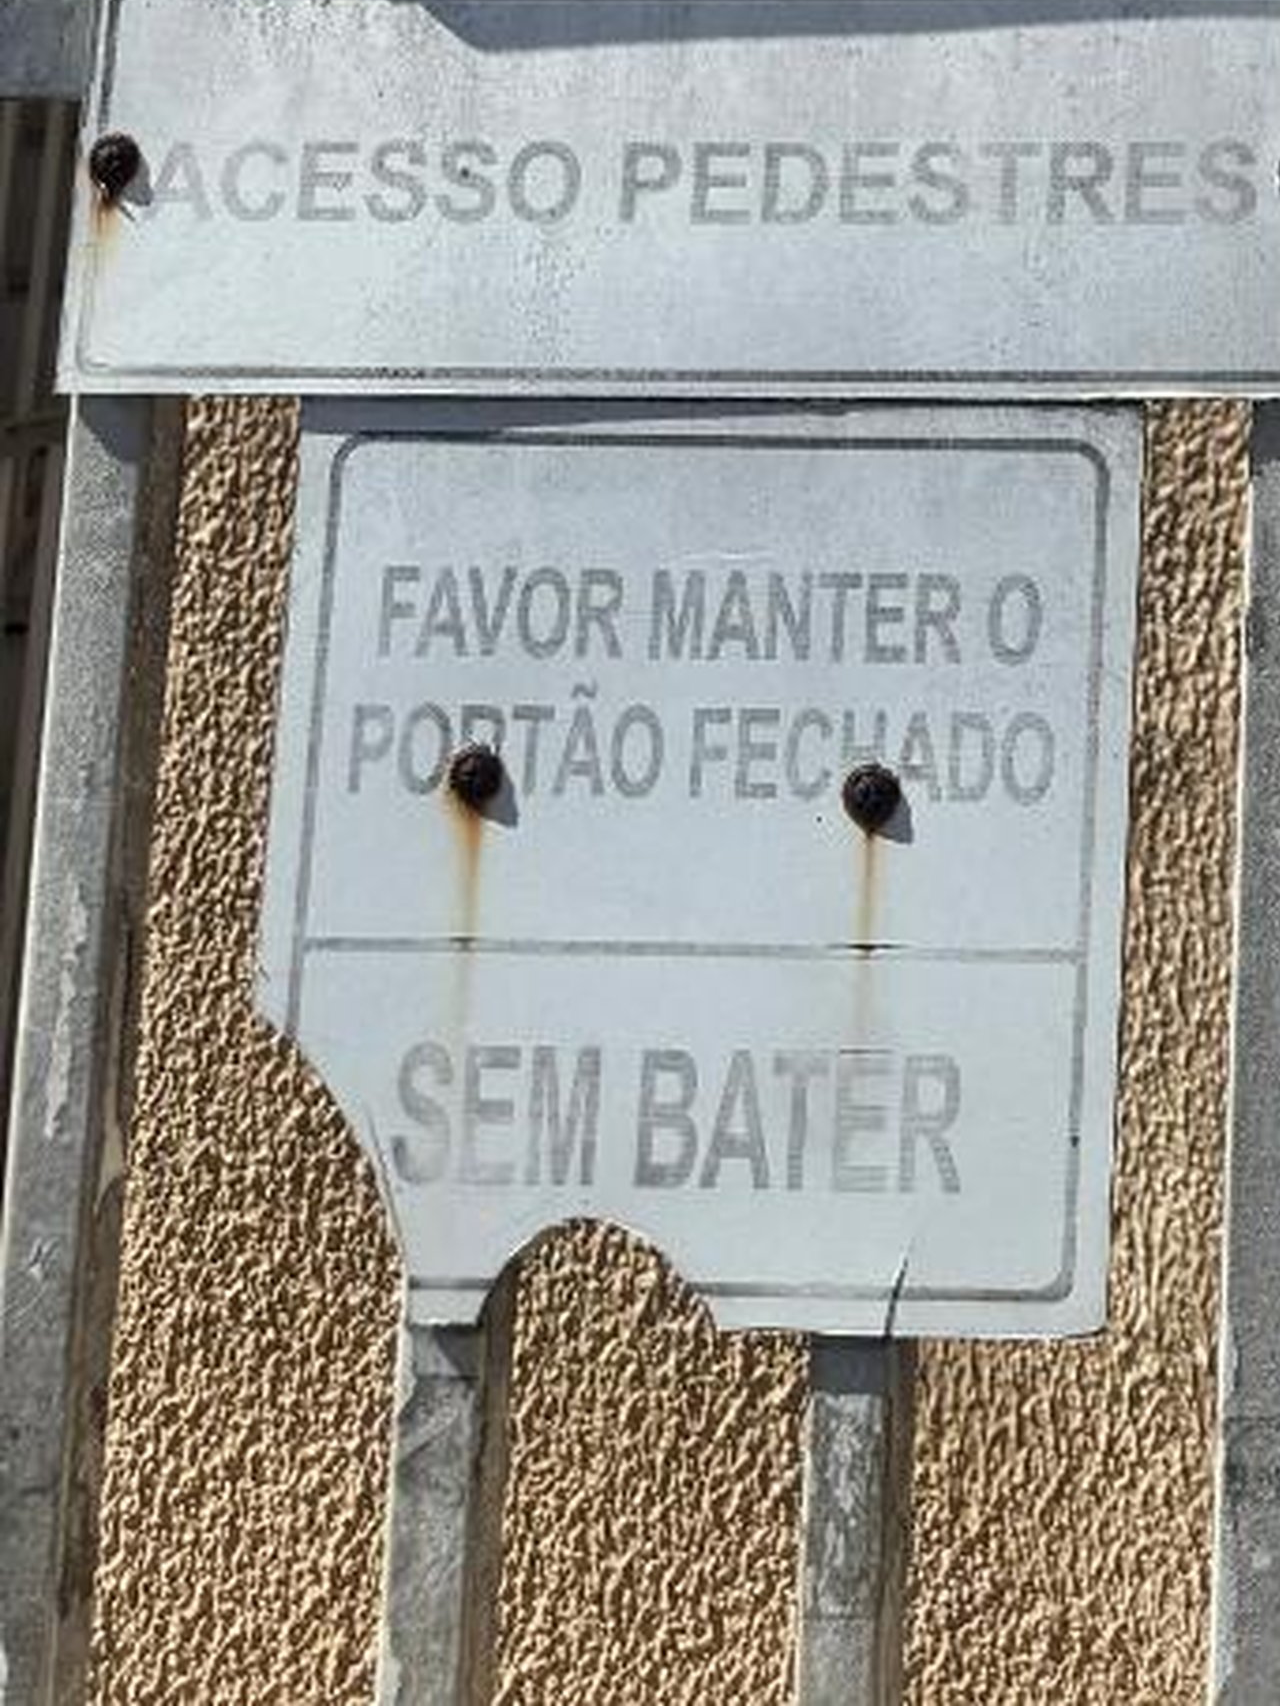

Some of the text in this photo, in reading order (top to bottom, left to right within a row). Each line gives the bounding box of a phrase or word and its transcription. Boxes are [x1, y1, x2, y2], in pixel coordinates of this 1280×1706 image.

[146, 140, 1260, 226] ACESSO PEDESTRES
[376, 564, 1044, 667] FAVOR MANTER O
[390, 1040, 962, 1195] SEM BATER
